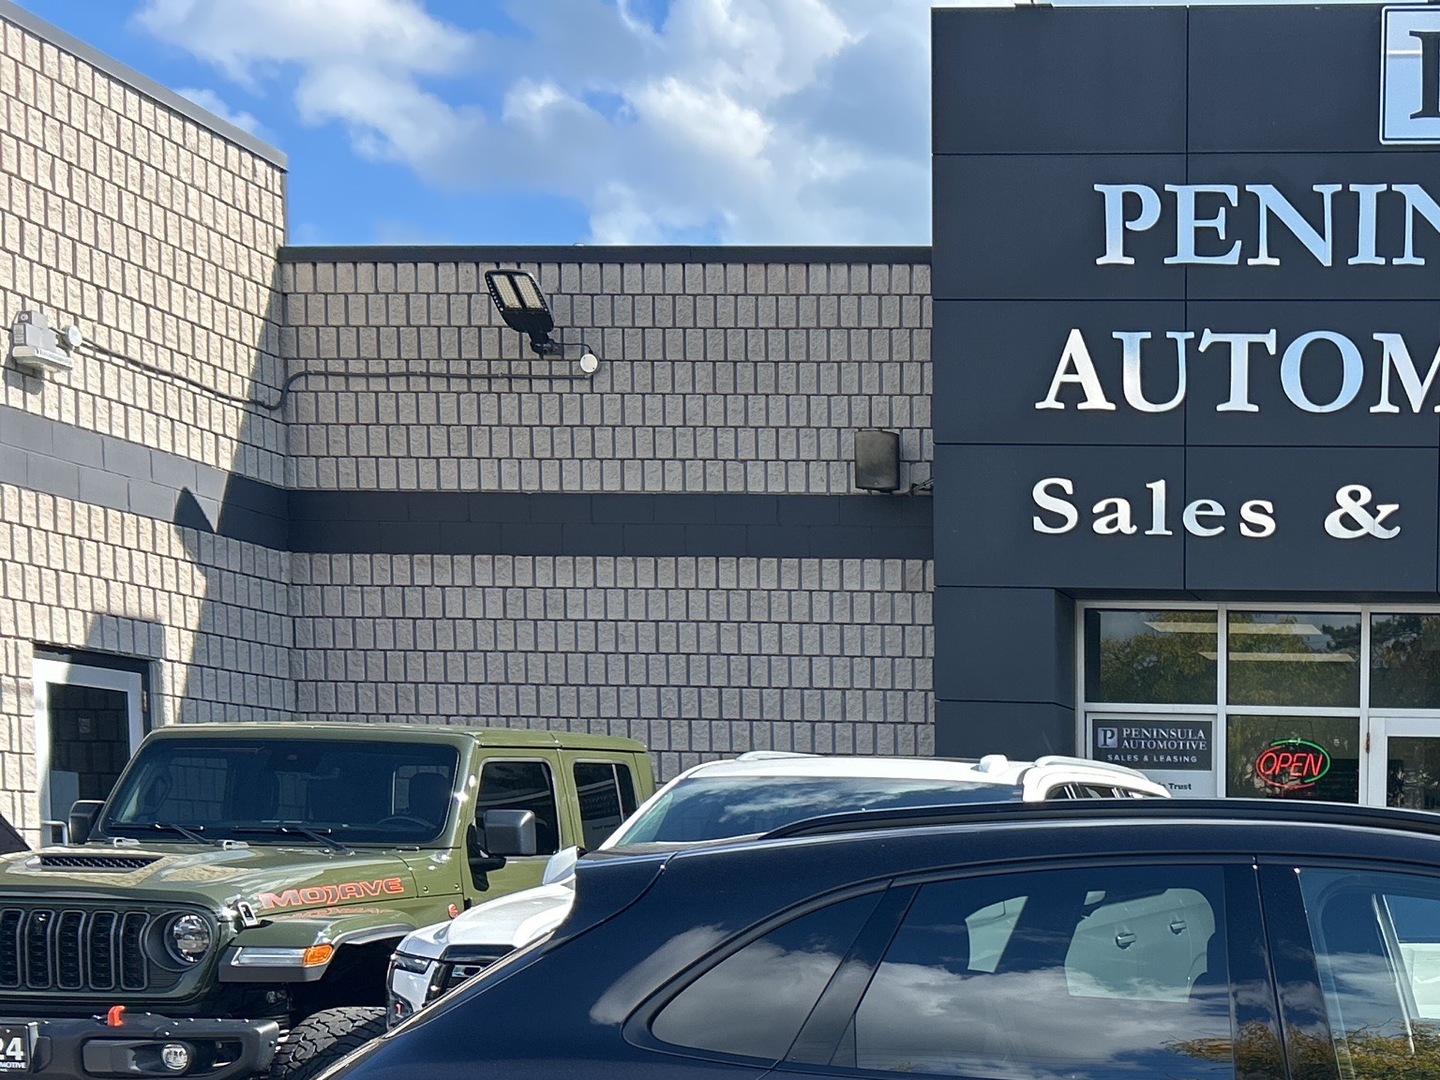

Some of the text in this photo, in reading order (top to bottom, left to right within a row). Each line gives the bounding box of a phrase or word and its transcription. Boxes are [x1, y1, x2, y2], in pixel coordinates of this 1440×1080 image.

[1032, 478, 1276, 538] Sales
[1324, 485, 1401, 540] &
[1101, 729, 1115, 746] P
[1122, 727, 1206, 740] PENINSULA
[1121, 740, 1207, 750] AUTOMOTIVE
[1107, 754, 1139, 762] SALES
[1153, 755, 1198, 763] LEASING
[1260, 752, 1323, 776] OPEN
[258, 877, 405, 909] MOJAVE
